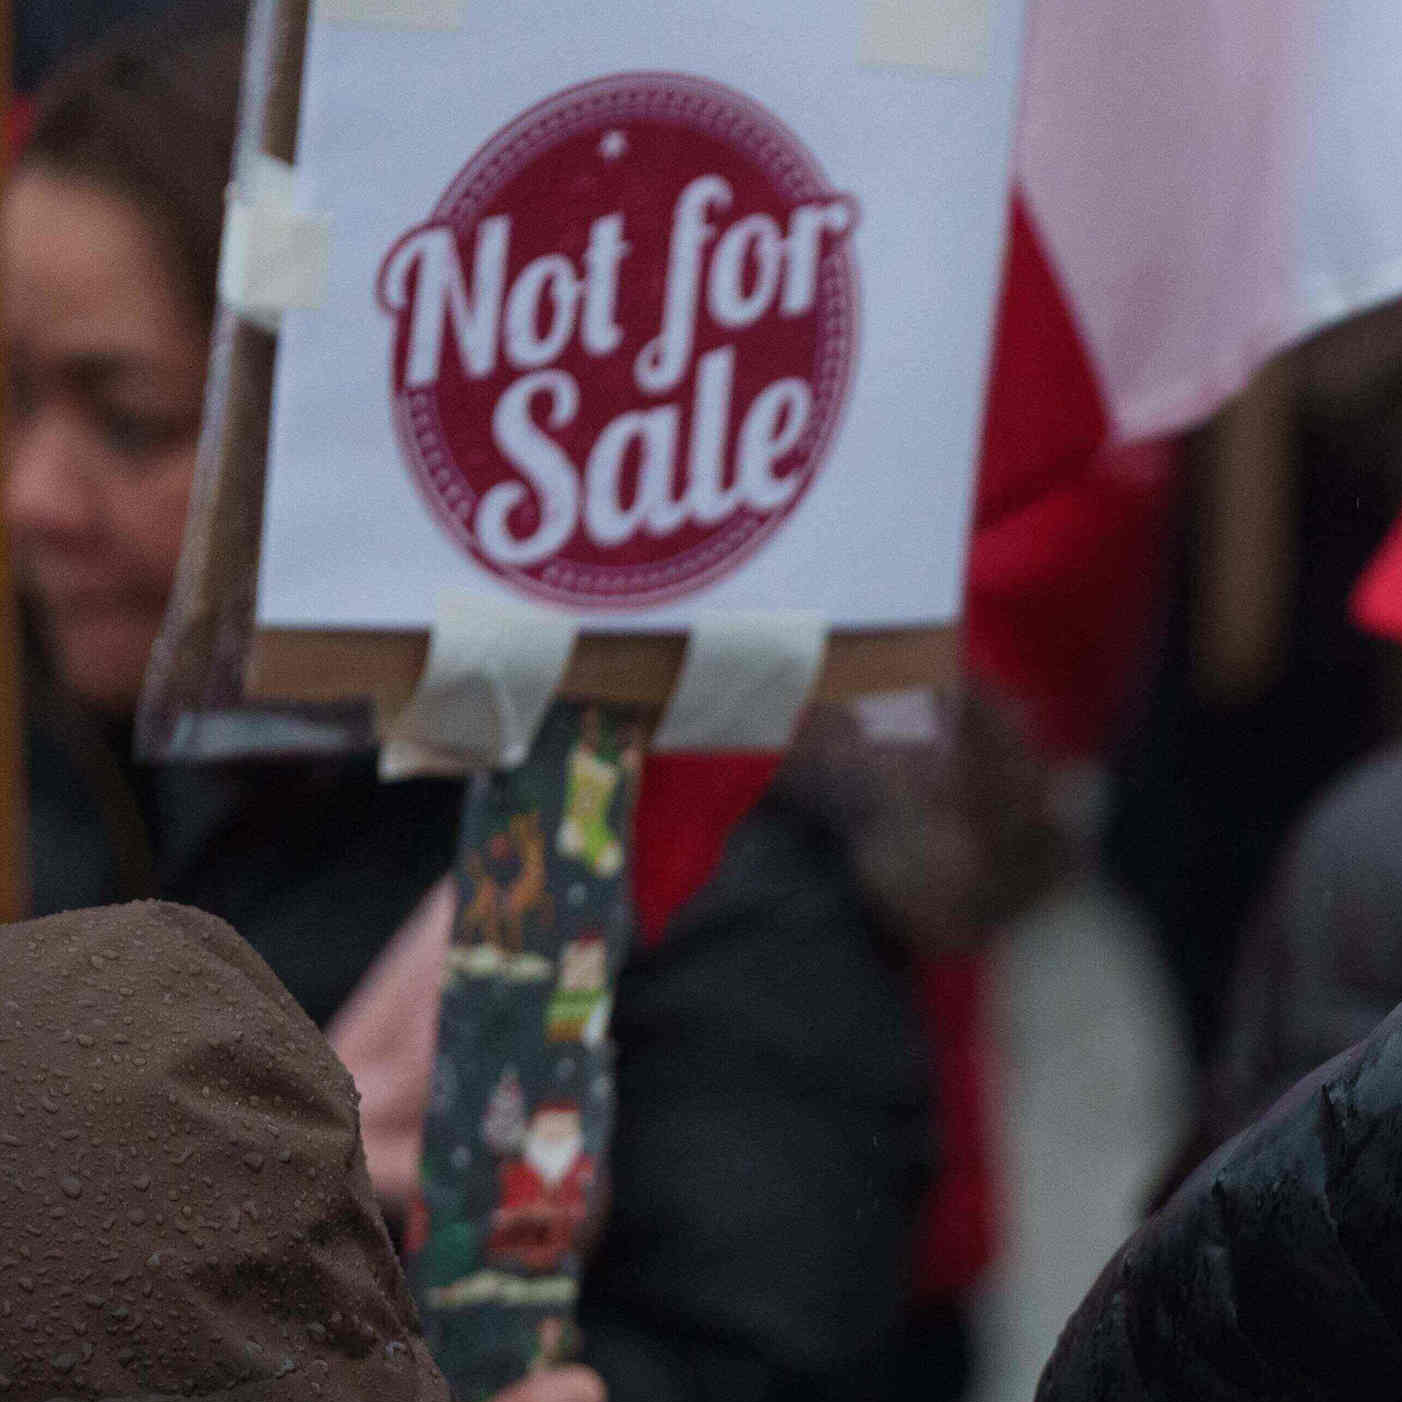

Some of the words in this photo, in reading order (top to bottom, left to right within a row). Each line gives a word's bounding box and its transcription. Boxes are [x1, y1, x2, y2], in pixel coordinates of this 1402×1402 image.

[382, 212, 631, 389] Not
[634, 174, 857, 391] for
[474, 346, 815, 568] Sale
